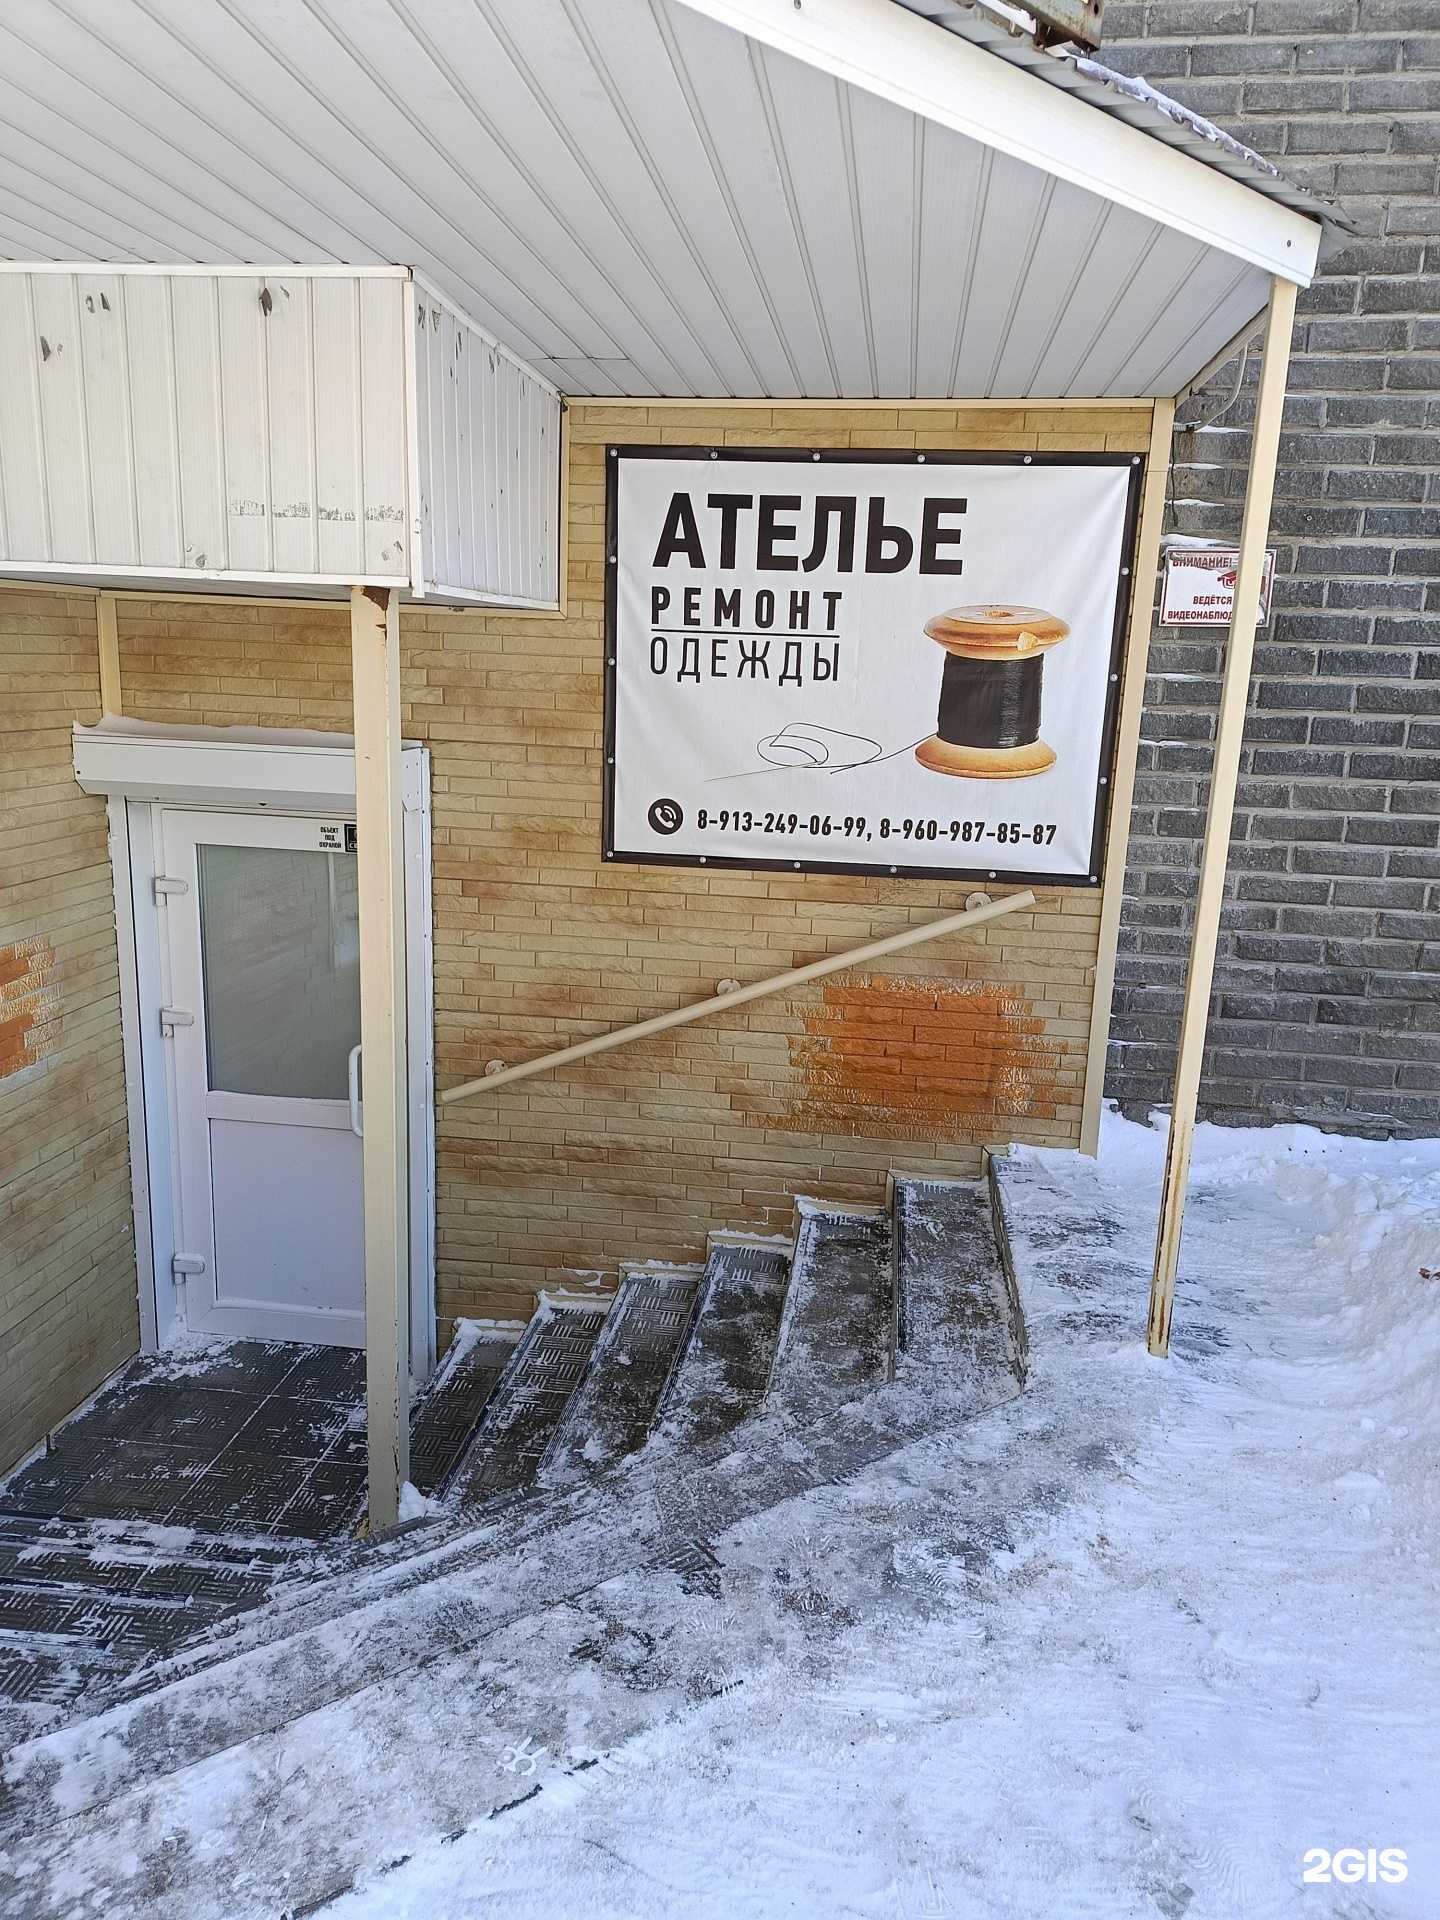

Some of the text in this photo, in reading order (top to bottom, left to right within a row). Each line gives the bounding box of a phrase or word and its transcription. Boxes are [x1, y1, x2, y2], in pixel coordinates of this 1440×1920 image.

[652, 492, 968, 575] АТЕЛЬЕ
[651, 586, 843, 631] РЕМОНТ
[1167, 611, 1233, 620] ВИДЕОНАБЛЮД
[1193, 595, 1232, 606] ВЕДЁТСЯ
[649, 636, 841, 687] ОДЕЖДЫ
[697, 810, 1057, 845] 8-913-249-06-99, 8-960-987-85-87
